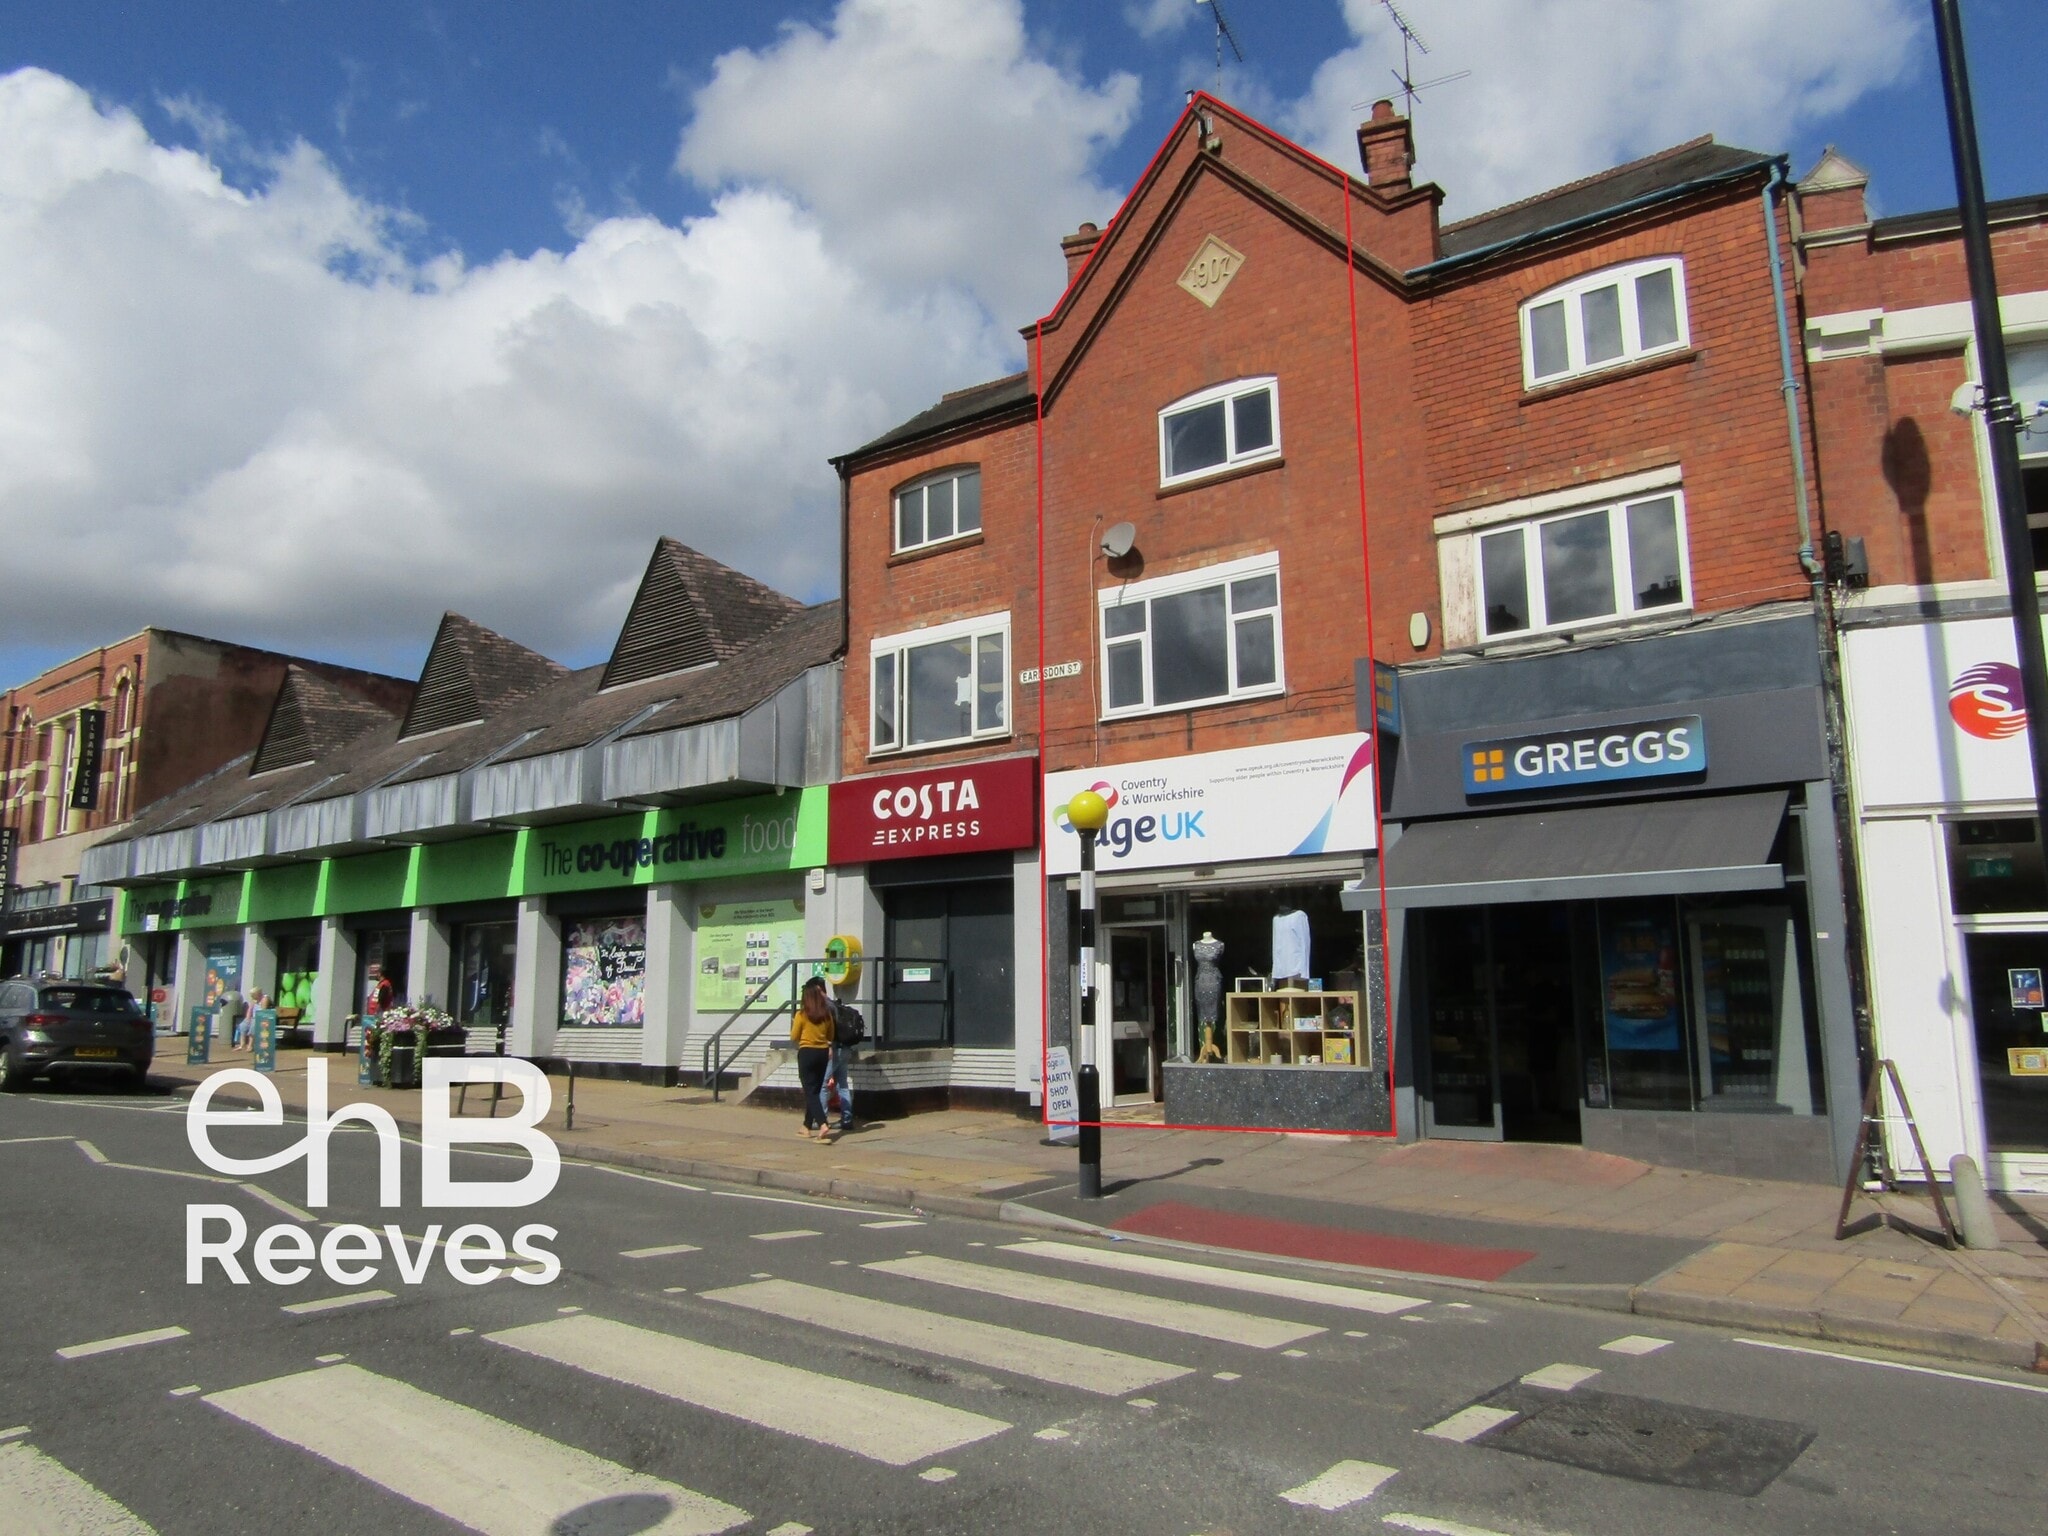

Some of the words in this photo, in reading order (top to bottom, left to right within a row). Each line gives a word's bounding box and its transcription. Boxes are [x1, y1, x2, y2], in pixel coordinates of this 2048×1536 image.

[1022, 665, 1065, 682] EARSDON
[1513, 727, 1692, 777] GREGGS
[1209, 776, 1235, 784] Supporting
[1283, 768, 1304, 776] Coventry
[1311, 763, 1345, 771] Warwickshire
[81, 769, 92, 803] CLUB
[1121, 777, 1168, 791] Coventry
[872, 779, 980, 820] COSTA
[1121, 795, 1129, 806] &
[1132, 787, 1205, 804] Warwickshire
[541, 841, 573, 878] The
[576, 822, 727, 877] co-operative
[742, 806, 797, 854] food
[888, 820, 980, 845] EXPRESS
[605, 964, 614, 979] of
[1049, 1085, 1069, 1097] SHOP
[1052, 1099, 1072, 1111] OPEN
